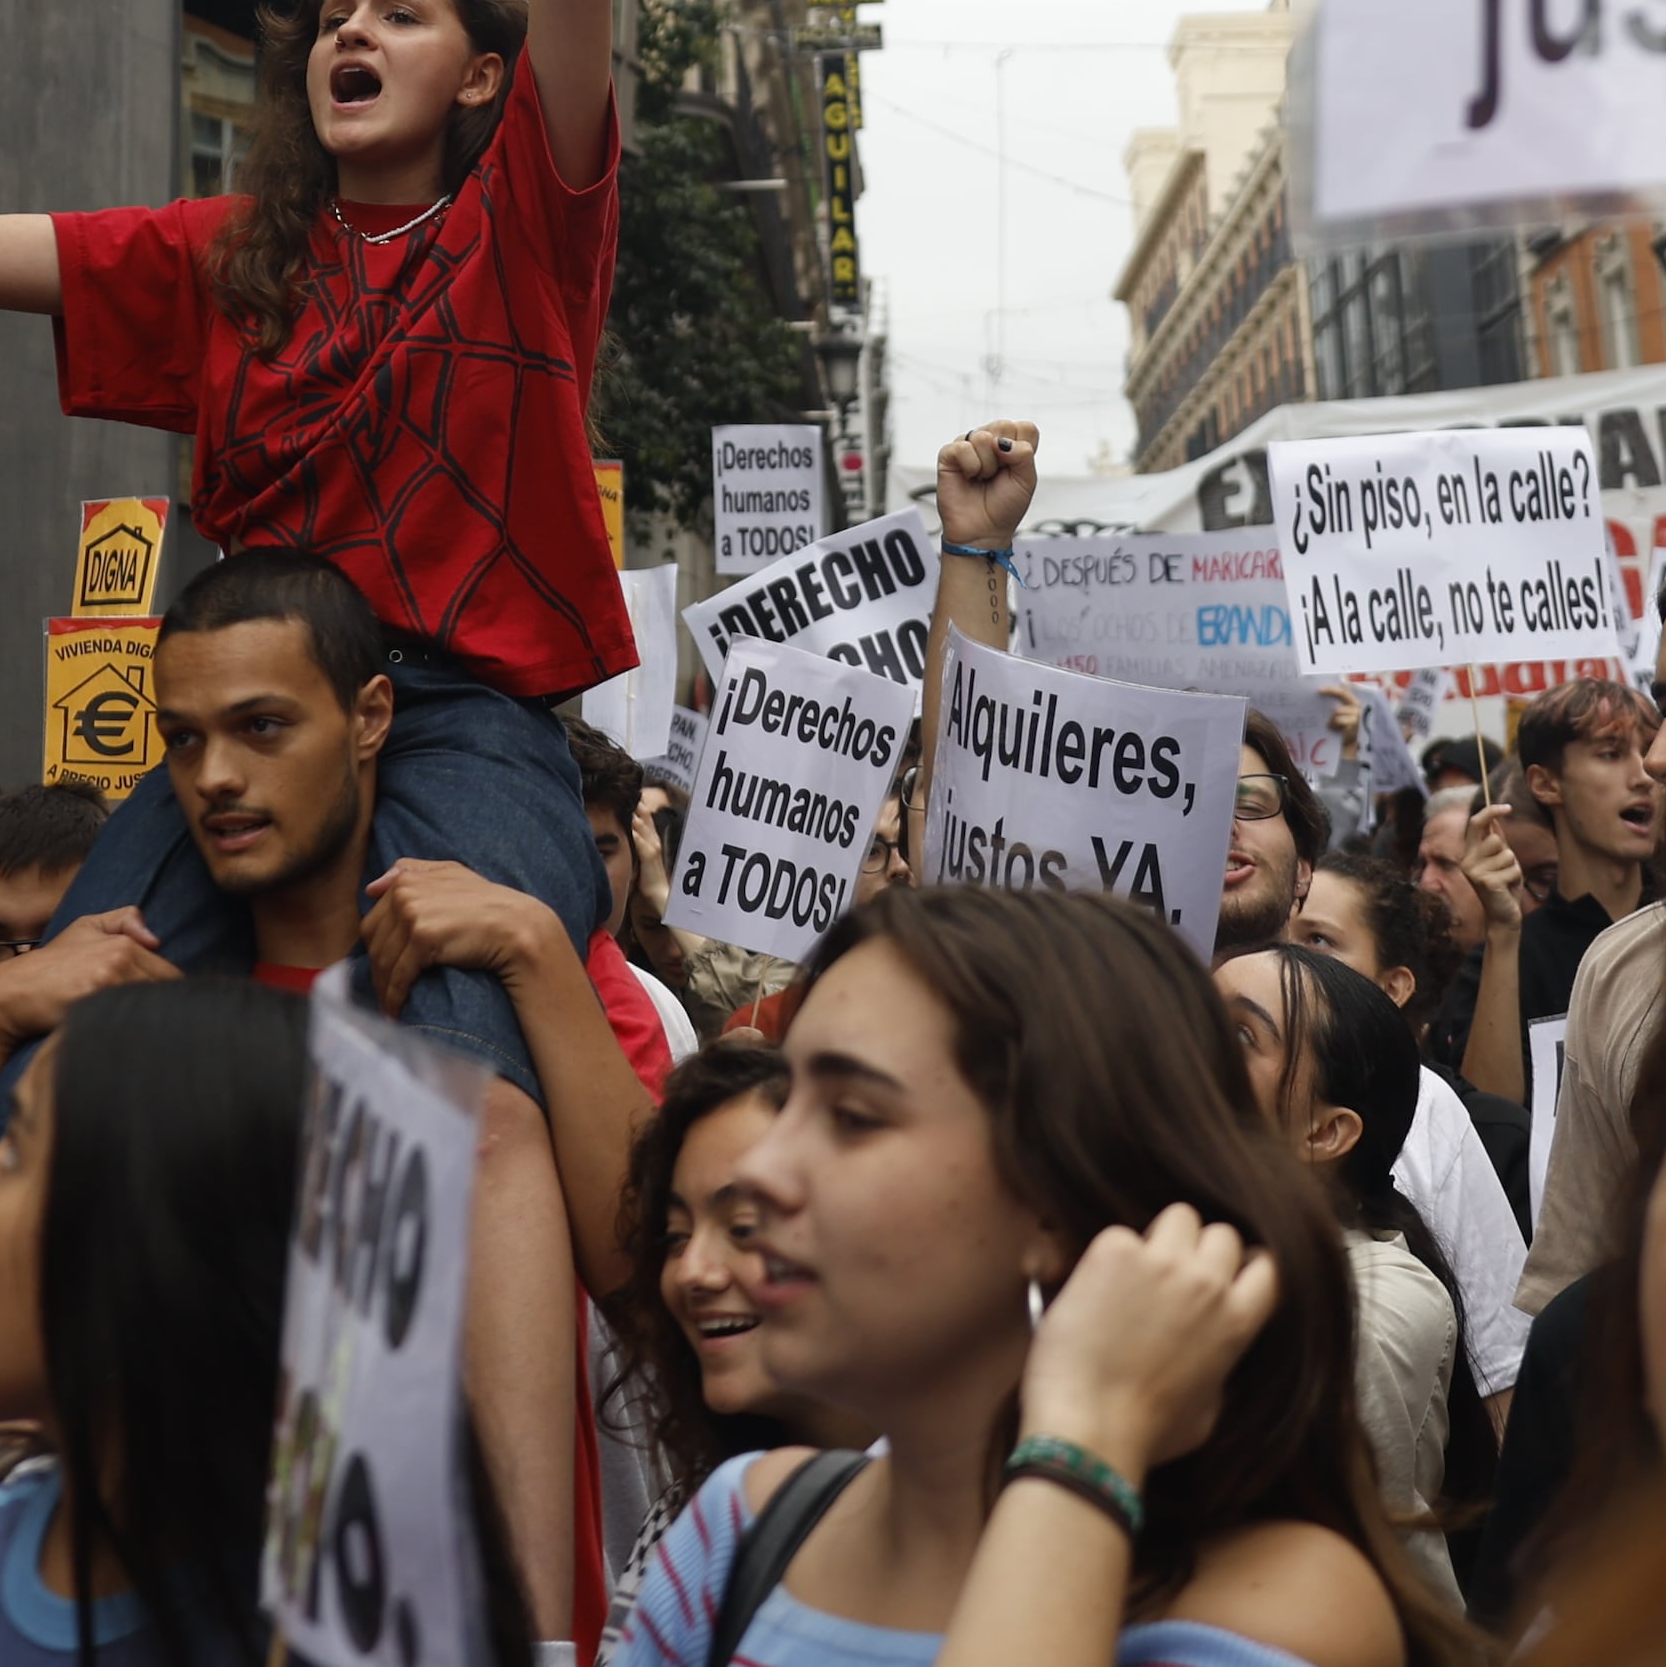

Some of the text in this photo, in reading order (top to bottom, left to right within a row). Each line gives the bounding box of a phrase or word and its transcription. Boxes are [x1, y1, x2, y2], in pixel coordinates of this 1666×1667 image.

[823, 72, 856, 283] AGUILAR
[717, 441, 814, 477] ¡Derechos
[721, 484, 811, 514] humanos
[1292, 462, 1353, 555] ¿Sin
[1360, 460, 1433, 550] piso,
[1437, 472, 1471, 525] en
[1473, 454, 1503, 525] la
[1509, 449, 1591, 522] calle?
[721, 533, 733, 557] a
[1149, 552, 1186, 584] DE
[1192, 547, 1285, 583] MARICAR
[88, 548, 139, 594] DIGNA
[1300, 574, 1334, 666] ¡A
[1333, 573, 1364, 645] la
[1368, 567, 1445, 652] calle,
[1449, 580, 1484, 635] no
[1485, 563, 1515, 634] te
[1520, 557, 1609, 634] calles!
[55, 638, 123, 662] VIVIENDA
[716, 667, 896, 768] ¡Derechos
[946, 660, 1196, 817] Alquileres,
[46, 763, 58, 779] A
[667, 743, 694, 776] CHO,
[705, 750, 860, 849] humanos
[681, 850, 707, 897] a
[937, 788, 1182, 926] justos YA.
